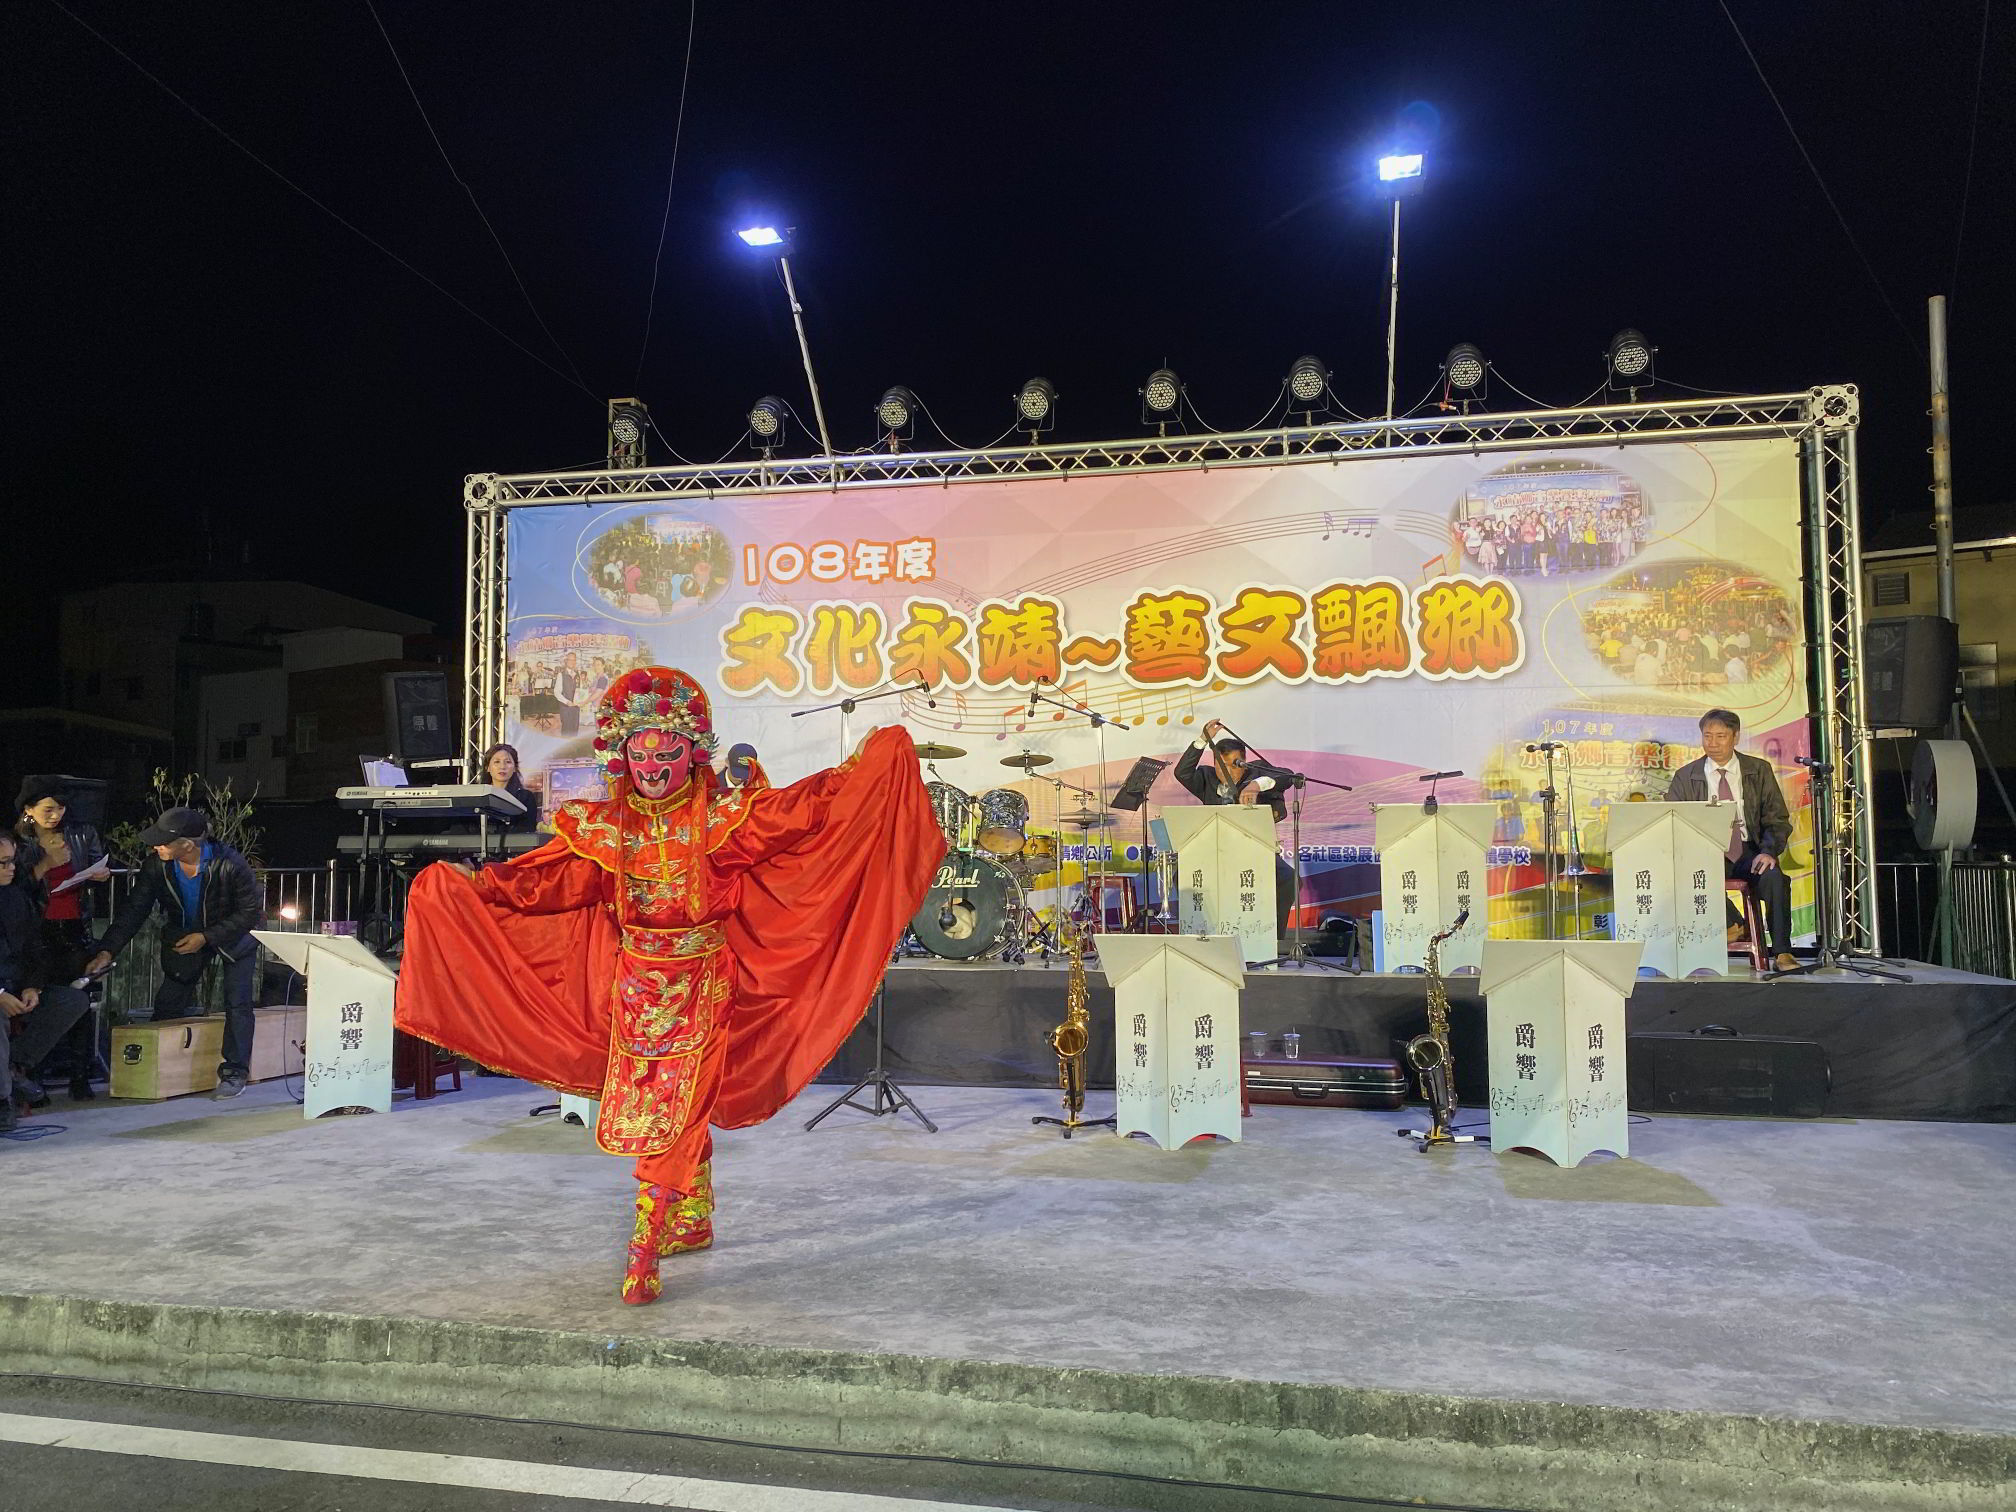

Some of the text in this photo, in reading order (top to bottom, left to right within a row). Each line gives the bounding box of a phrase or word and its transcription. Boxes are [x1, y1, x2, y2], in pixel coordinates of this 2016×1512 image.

[744, 536, 936, 586] 108年度
[931, 865, 980, 889] Pearl
[341, 1001, 363, 1050] 爵響
[1133, 1013, 1148, 1068] 爵響
[1194, 1013, 1214, 1070] 爵響
[1515, 1022, 1536, 1081] 爵響
[1587, 1023, 1605, 1083] 爵響
